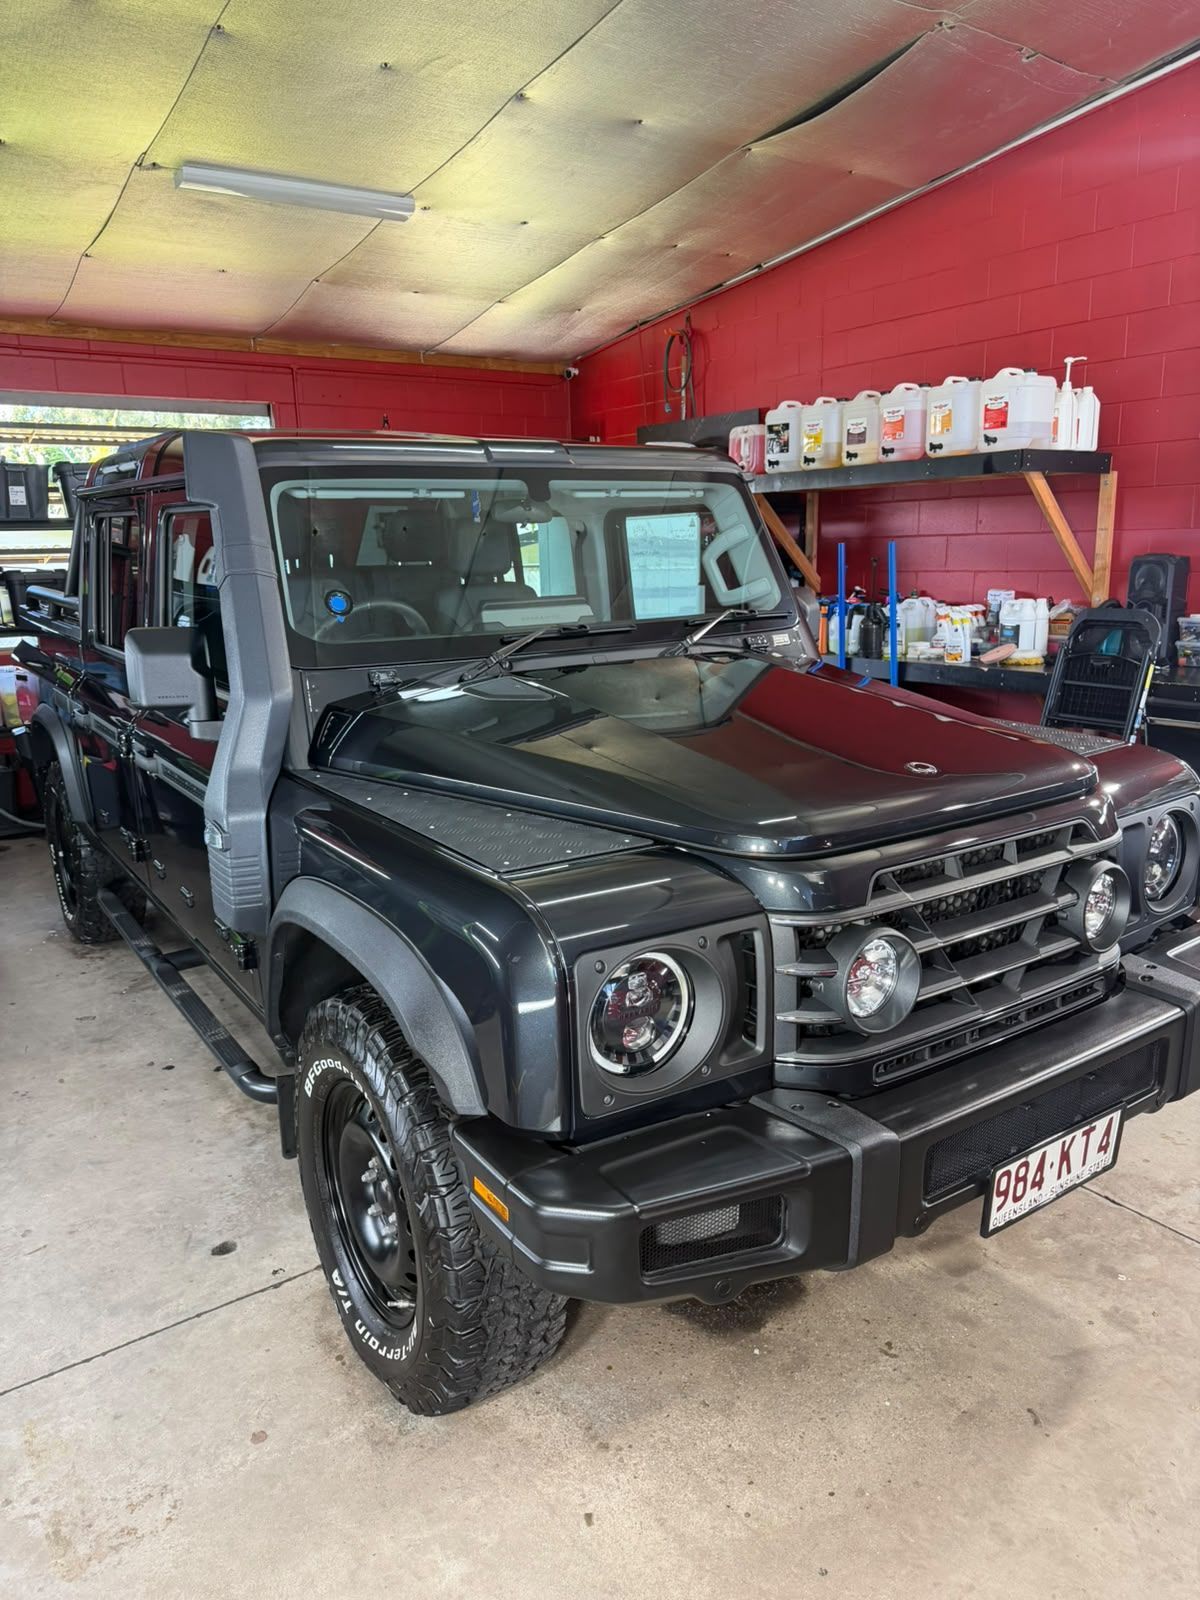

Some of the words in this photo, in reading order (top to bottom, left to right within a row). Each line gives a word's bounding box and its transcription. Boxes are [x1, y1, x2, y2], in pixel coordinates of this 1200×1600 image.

[992, 1193, 1044, 1227] QUEENSLAND
[1087, 1157, 1110, 1174] STATE
[331, 1268, 353, 1314] T/A
